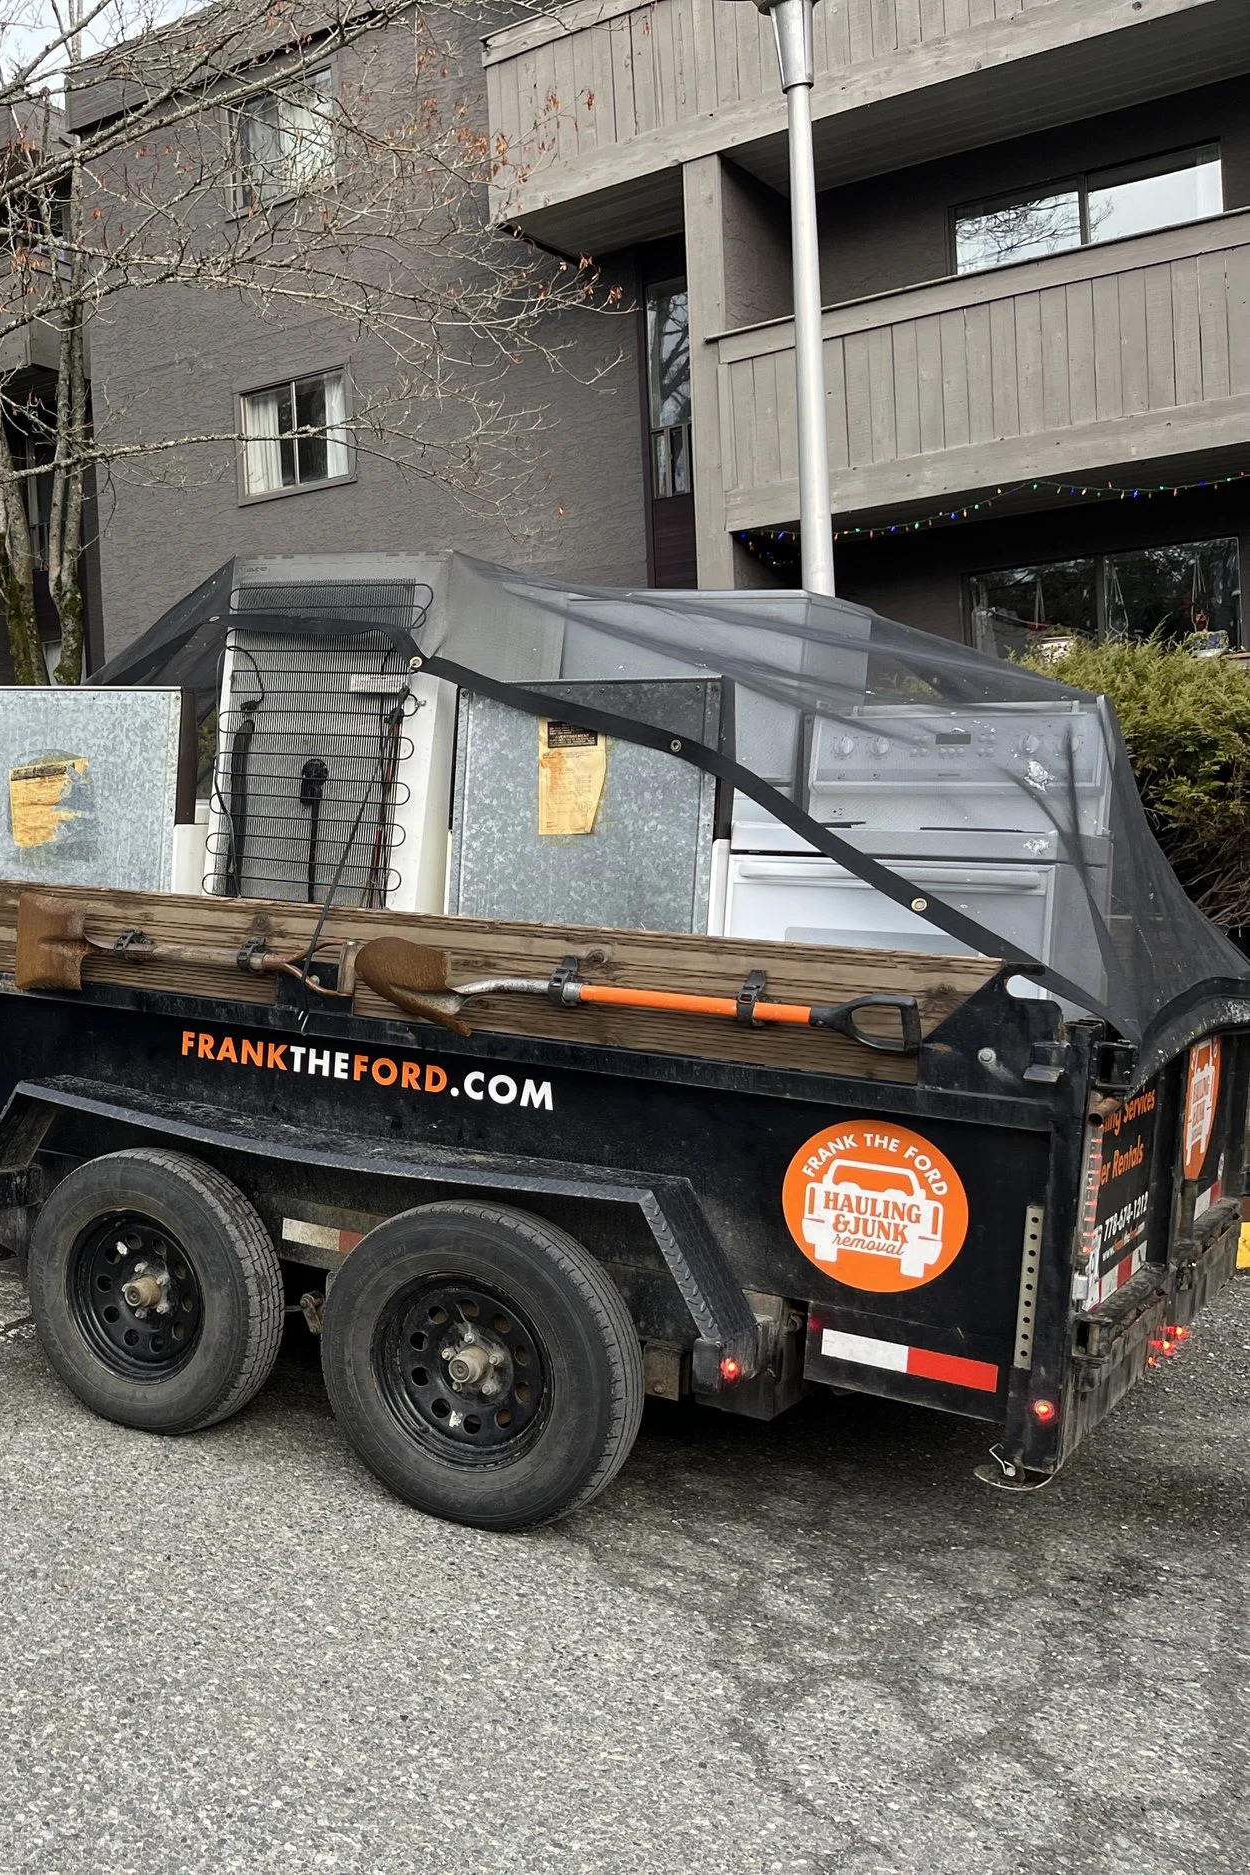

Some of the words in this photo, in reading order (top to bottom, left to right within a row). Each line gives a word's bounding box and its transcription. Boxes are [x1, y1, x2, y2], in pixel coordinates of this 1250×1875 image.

[181, 1030, 554, 1111] FRANKTHEFORD.COM
[1122, 1085, 1156, 1124] Services
[801, 1133, 858, 1177] FRANK
[863, 1133, 900, 1153] THE
[903, 1145, 948, 1196] FORD
[1112, 1135, 1145, 1179] Rentals
[823, 1190, 922, 1225] HAULING
[1103, 1191, 1149, 1242] 778-674-1212
[831, 1231, 906, 1256] removal
[832, 1213, 909, 1244] &JUNK
